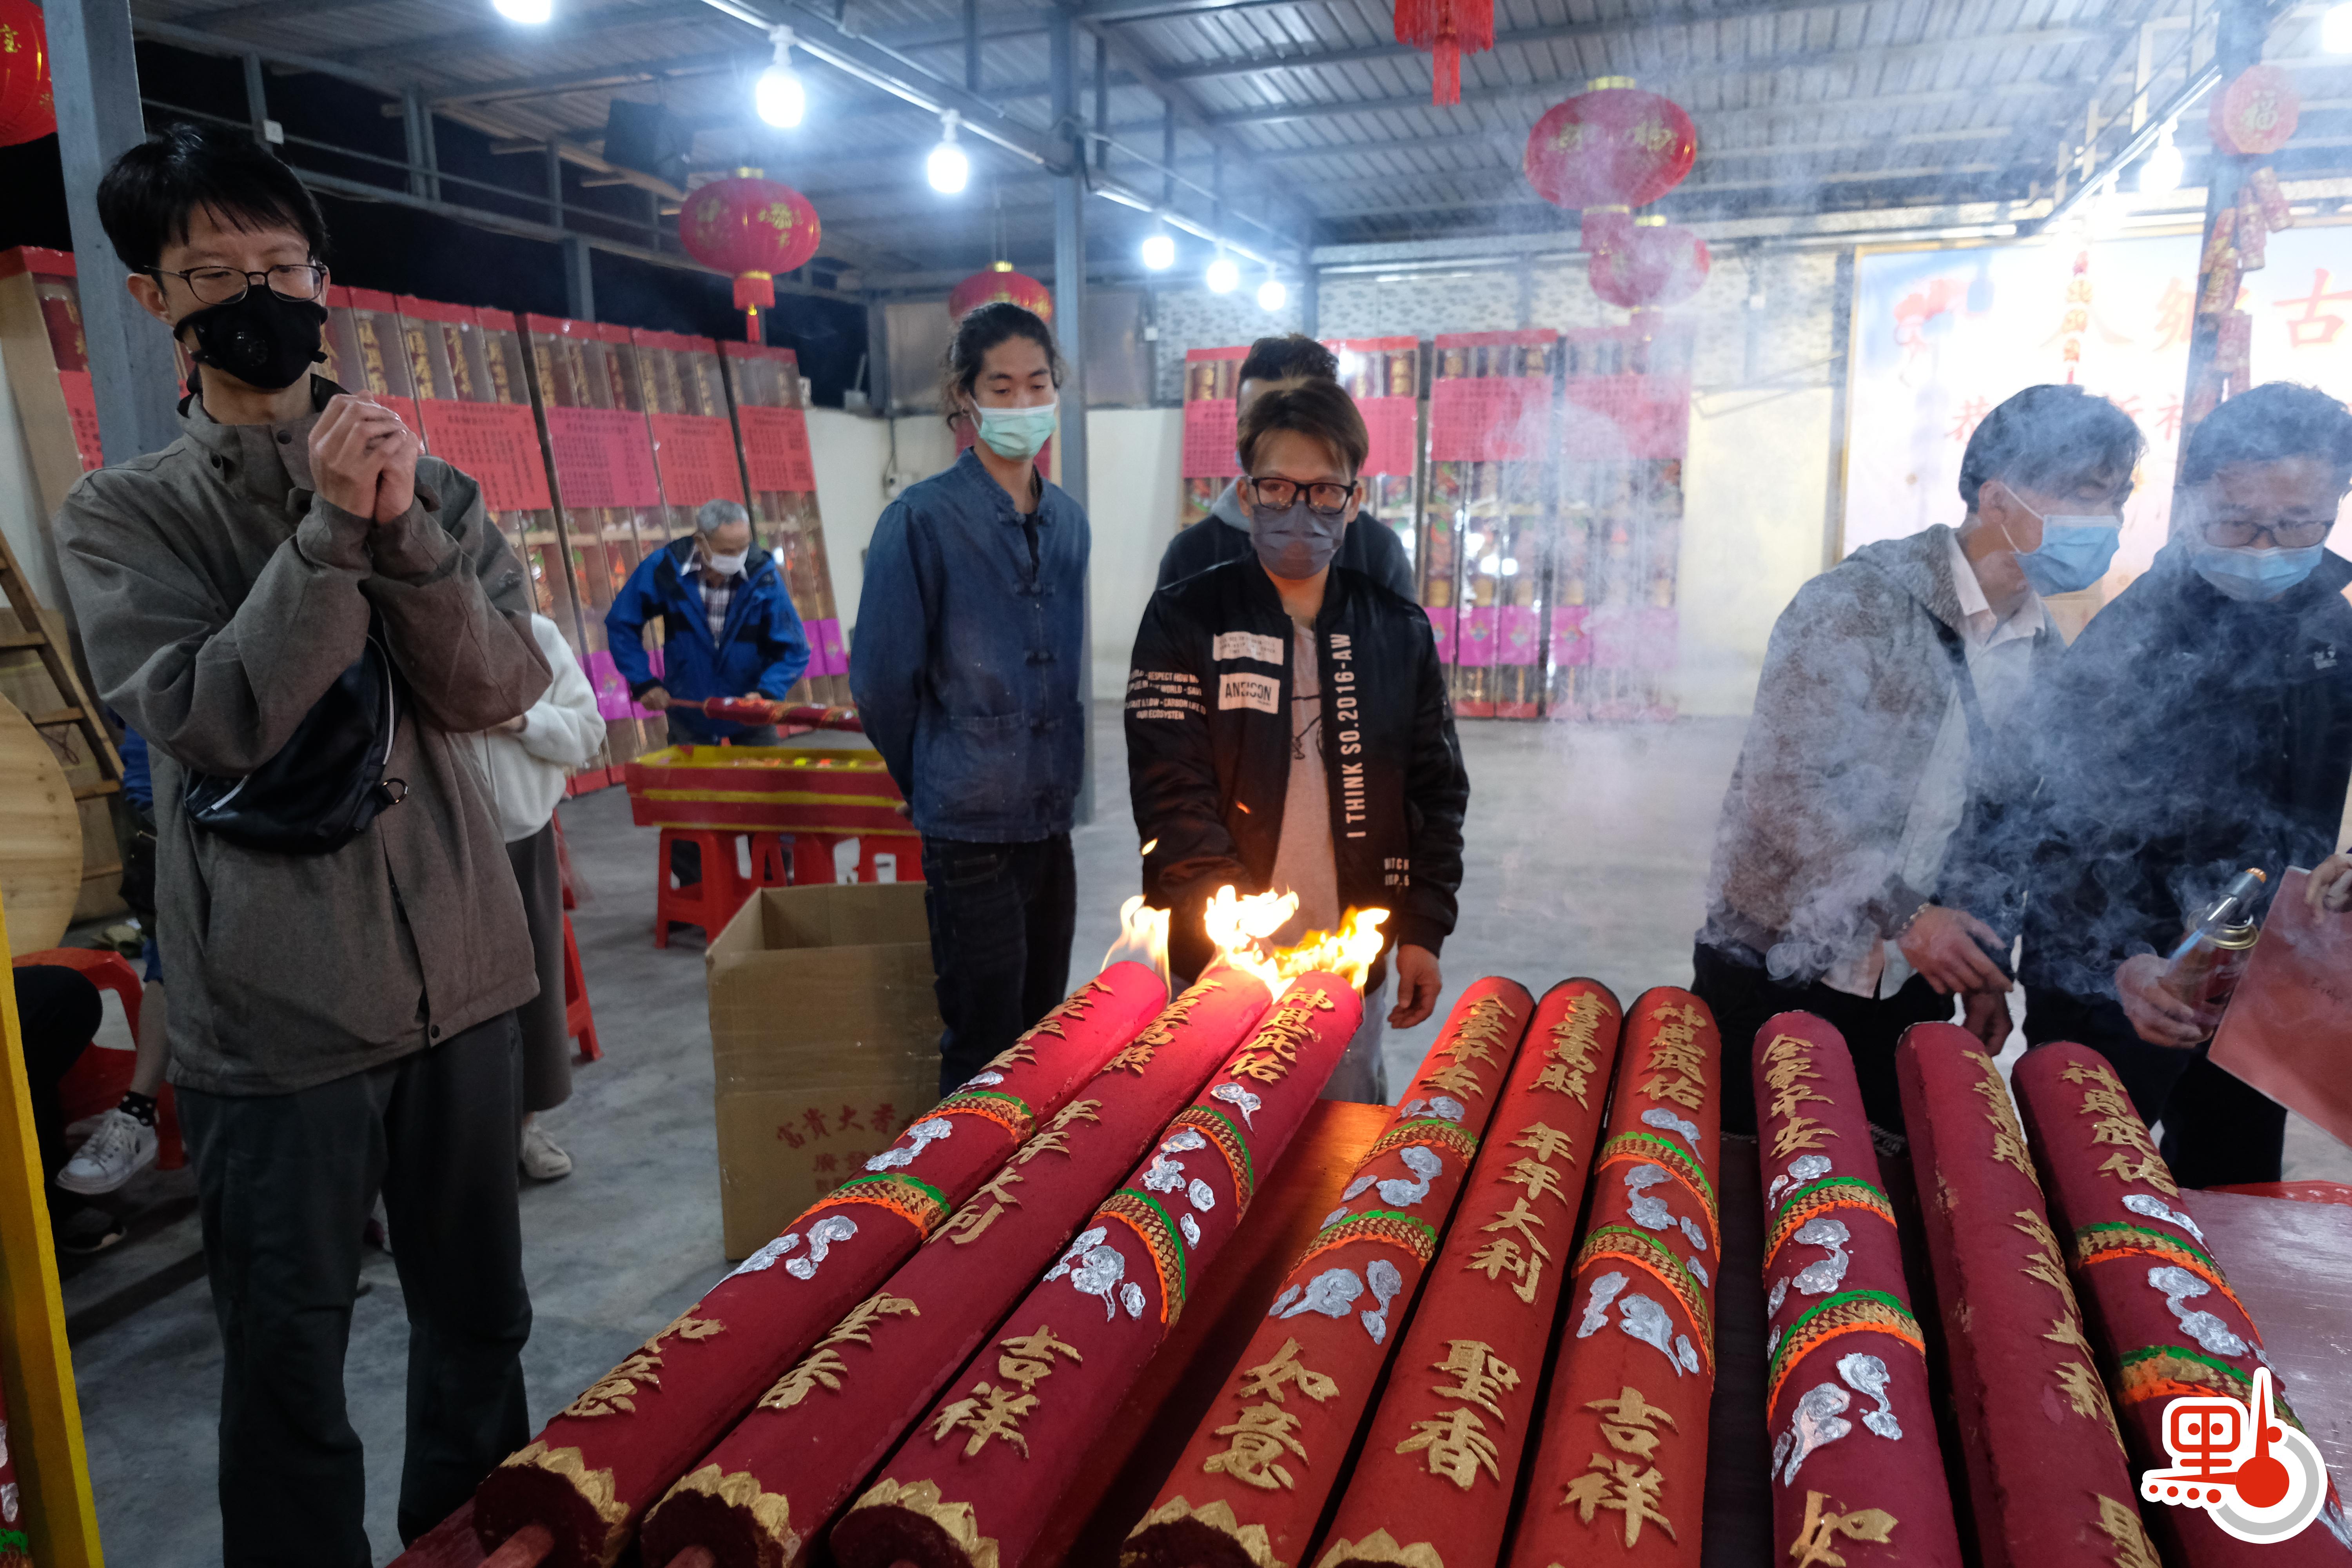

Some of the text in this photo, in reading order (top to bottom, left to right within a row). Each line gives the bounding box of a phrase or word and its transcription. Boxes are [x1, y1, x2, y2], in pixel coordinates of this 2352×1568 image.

[1341, 762, 1366, 823] THINK
[1464, 1122, 1575, 1304] 年年大利
[933, 1325, 1083, 1459] 吉祥
[1203, 1338, 1341, 1490] 如意
[1560, 1385, 1679, 1548] 吉祥
